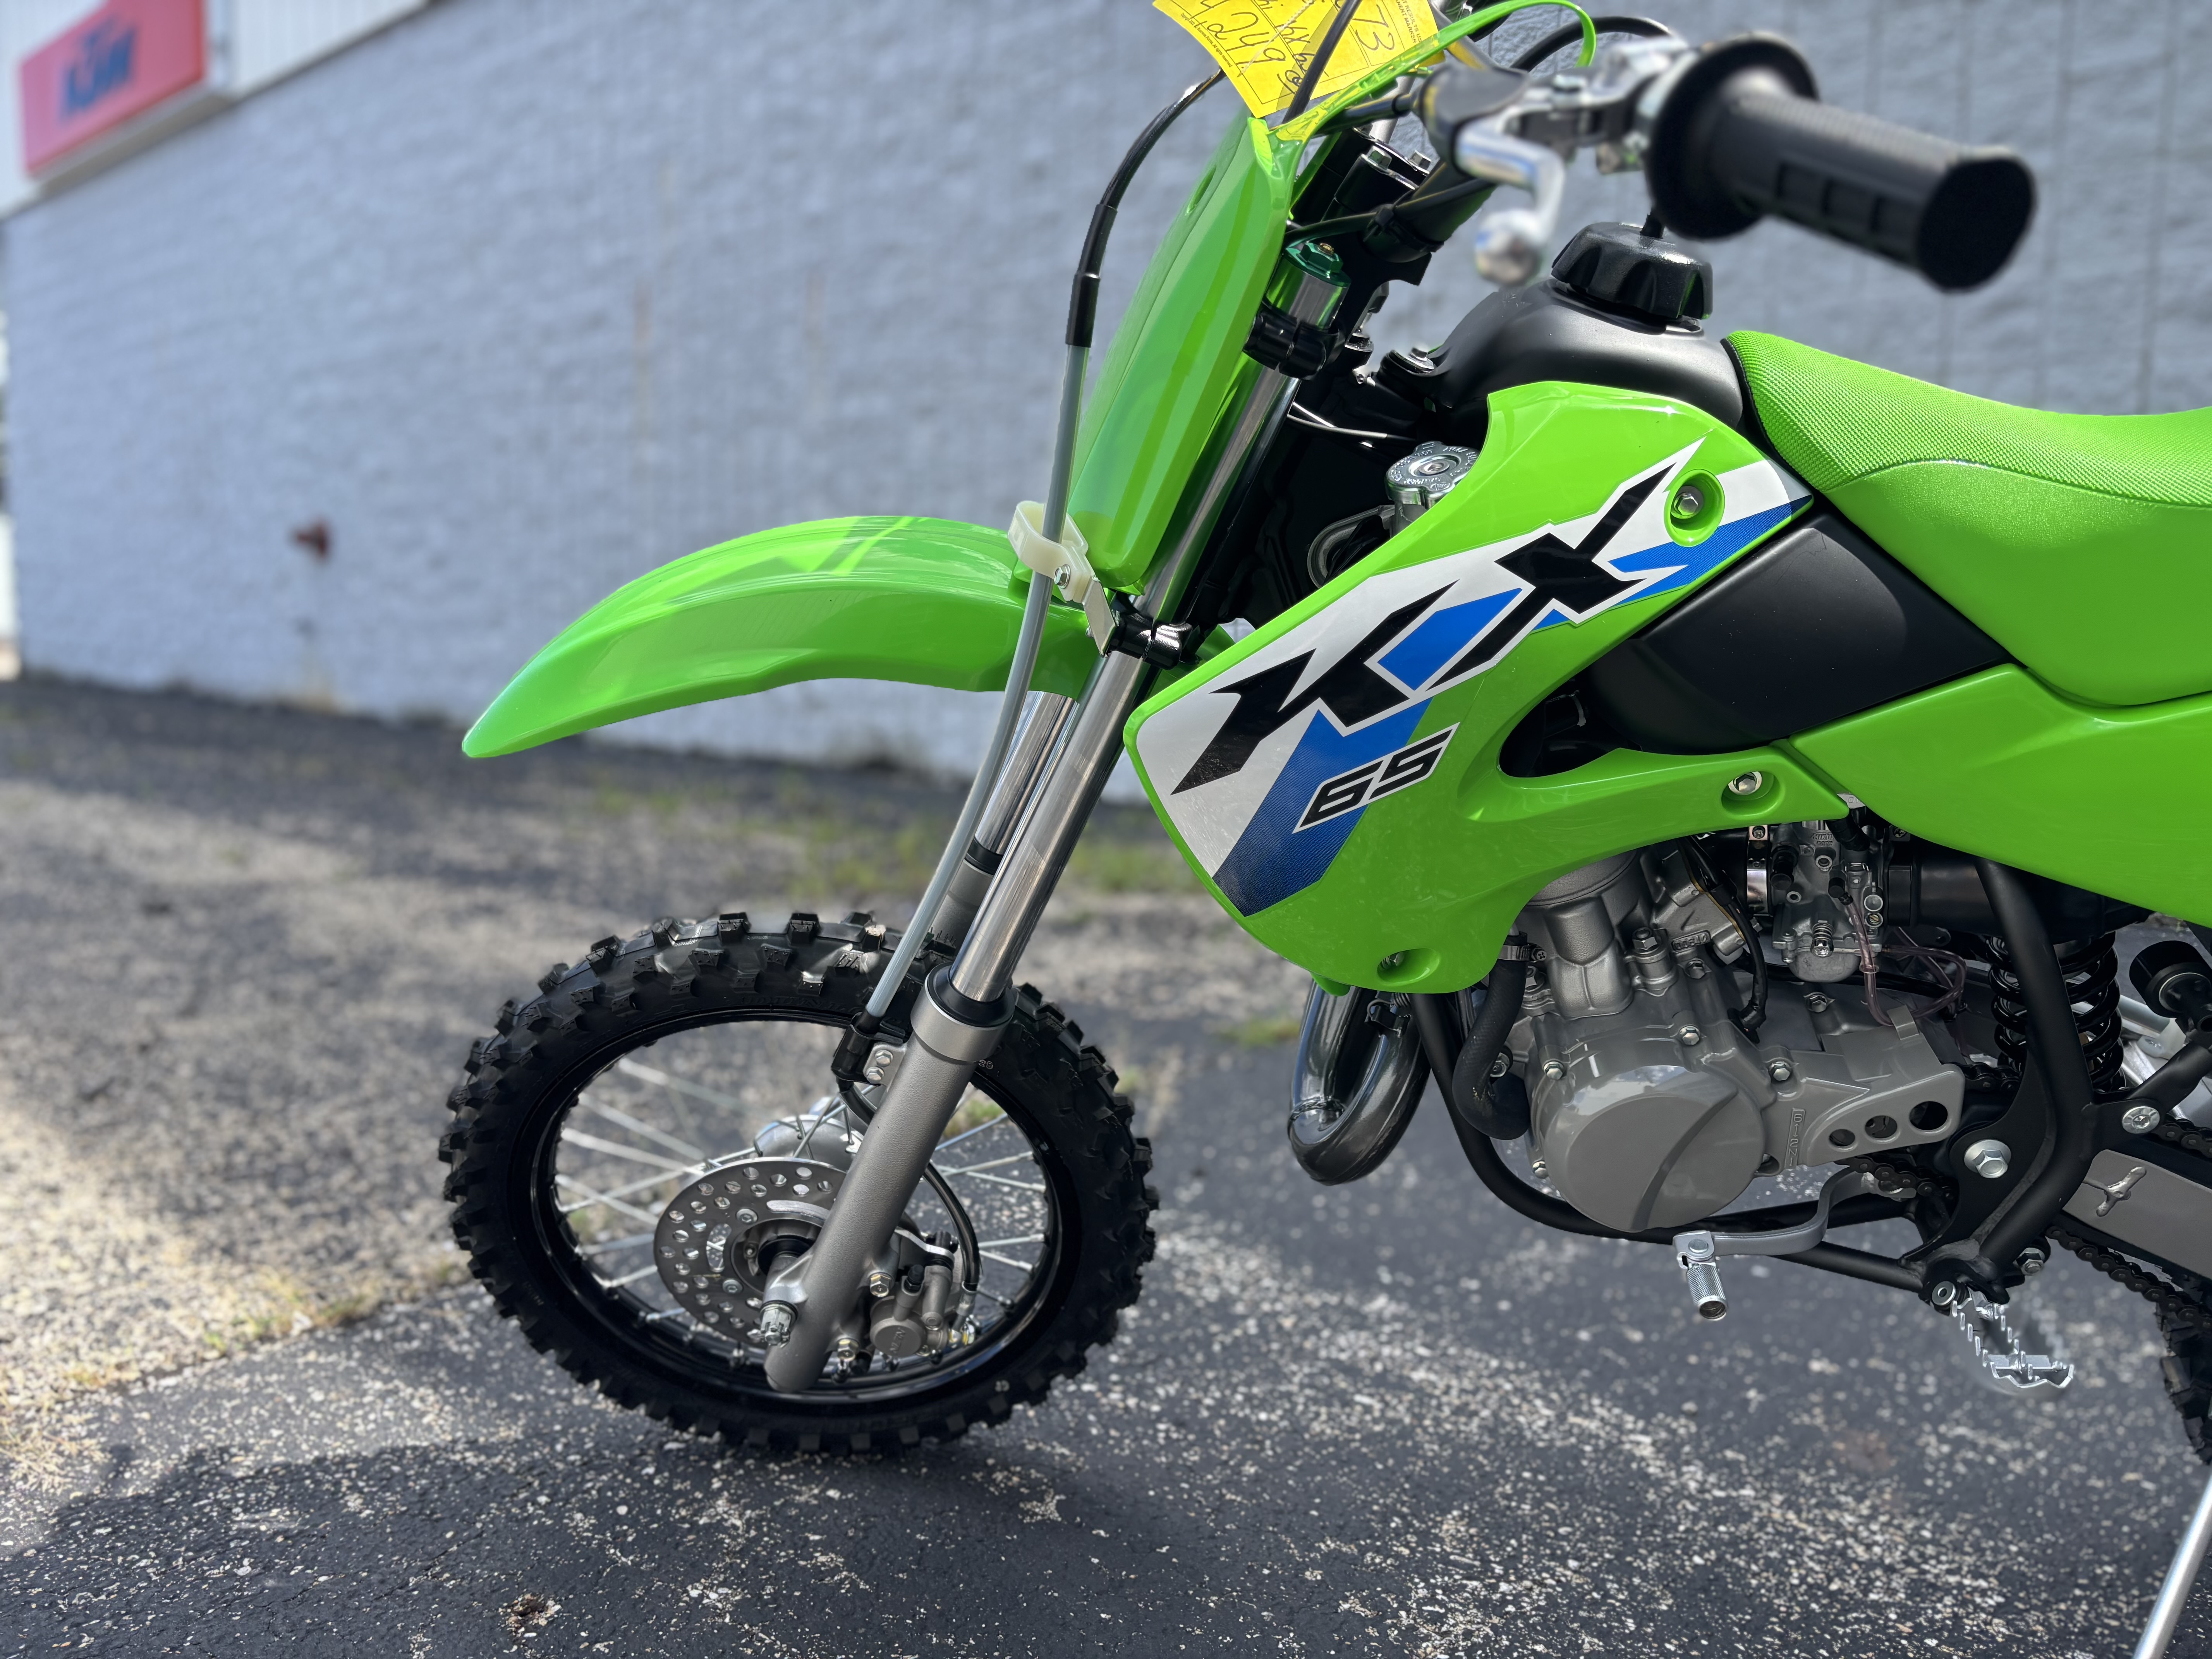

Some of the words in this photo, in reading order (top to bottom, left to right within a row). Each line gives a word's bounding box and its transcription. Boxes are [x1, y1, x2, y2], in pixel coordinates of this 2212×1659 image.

[1404, 17, 1417, 43] MARKER
[1405, 3, 1419, 32] RESULTS
[1172, 463, 1676, 795] KX
[1301, 728, 1452, 830] 65
[1793, 1113, 1803, 1123] 6
